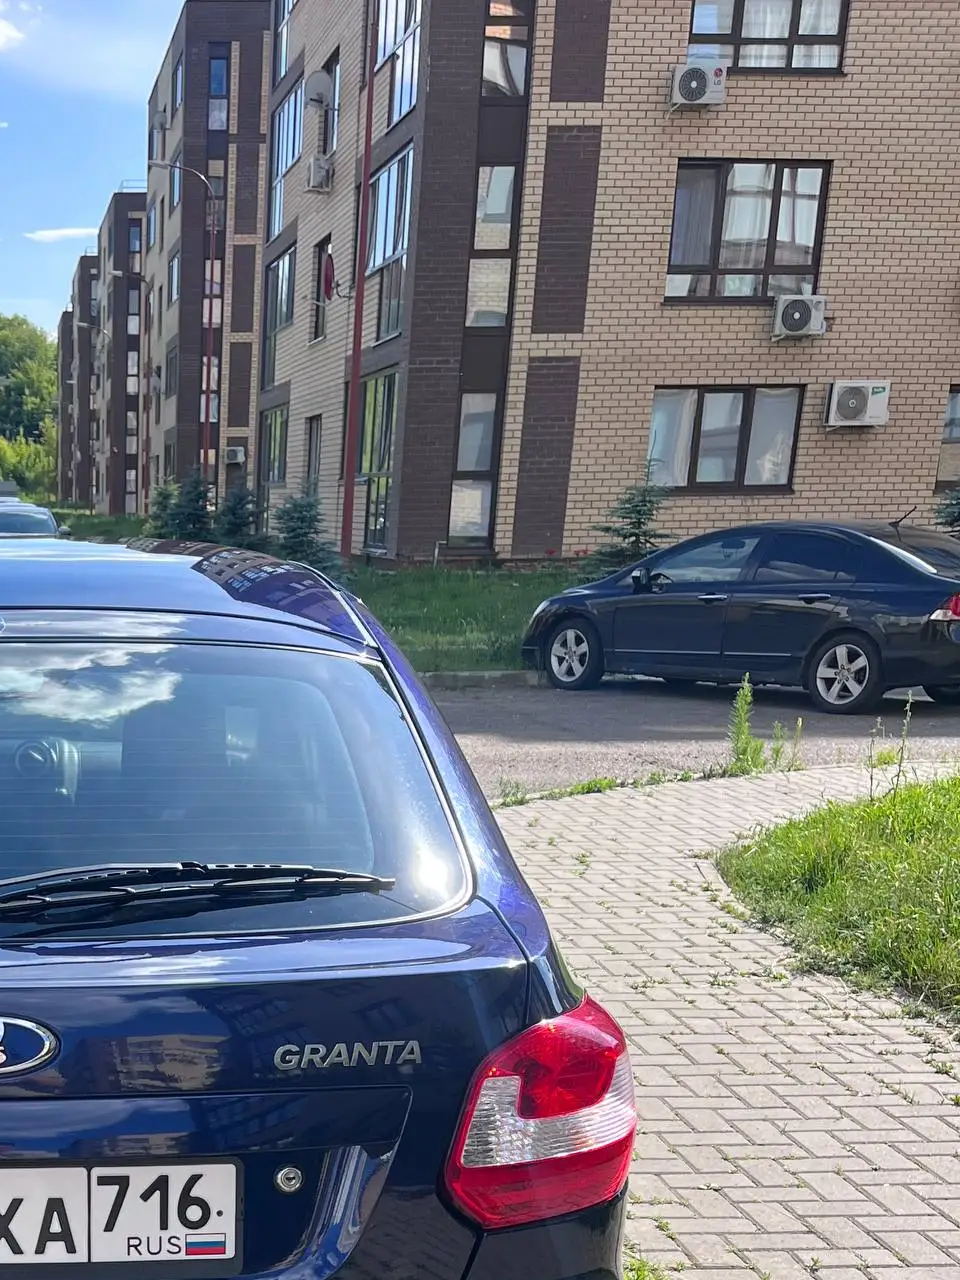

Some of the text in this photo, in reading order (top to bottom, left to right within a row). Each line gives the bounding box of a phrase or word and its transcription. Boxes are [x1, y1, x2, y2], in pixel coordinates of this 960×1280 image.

[273, 1039, 422, 1070] GRANTA
[96, 1173, 213, 1232] 716
[127, 1235, 182, 1256] RUS
